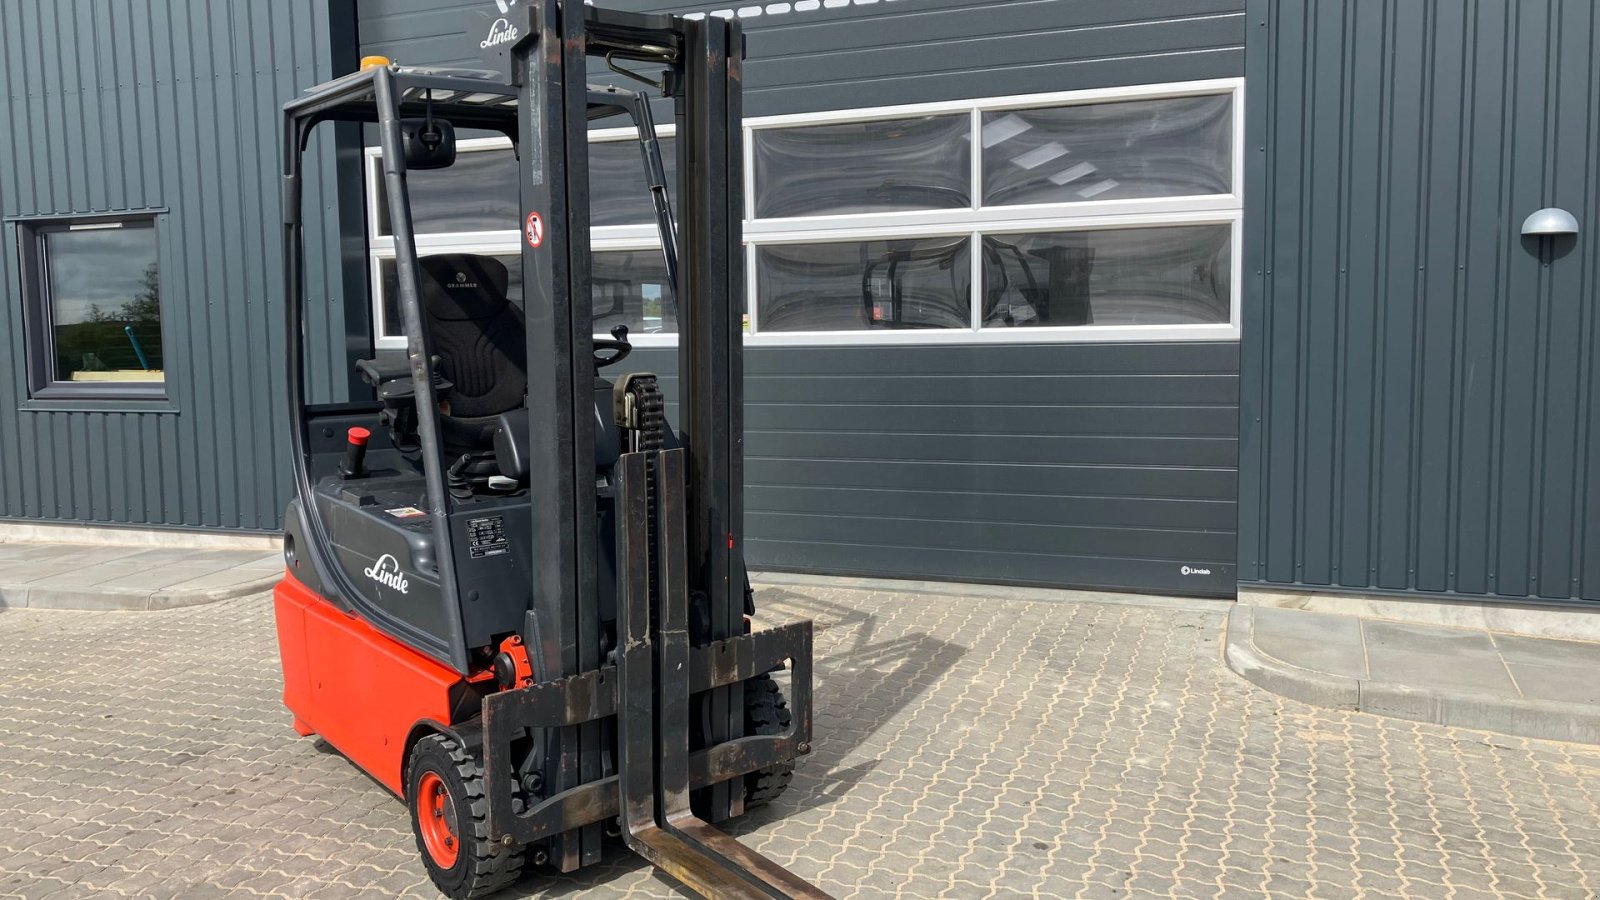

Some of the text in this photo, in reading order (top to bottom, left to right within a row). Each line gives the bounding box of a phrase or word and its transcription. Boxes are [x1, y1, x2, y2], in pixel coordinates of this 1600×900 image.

[480, 18, 518, 48] Linde
[364, 553, 409, 594] Linde
[1190, 567, 1211, 575] Lindab
